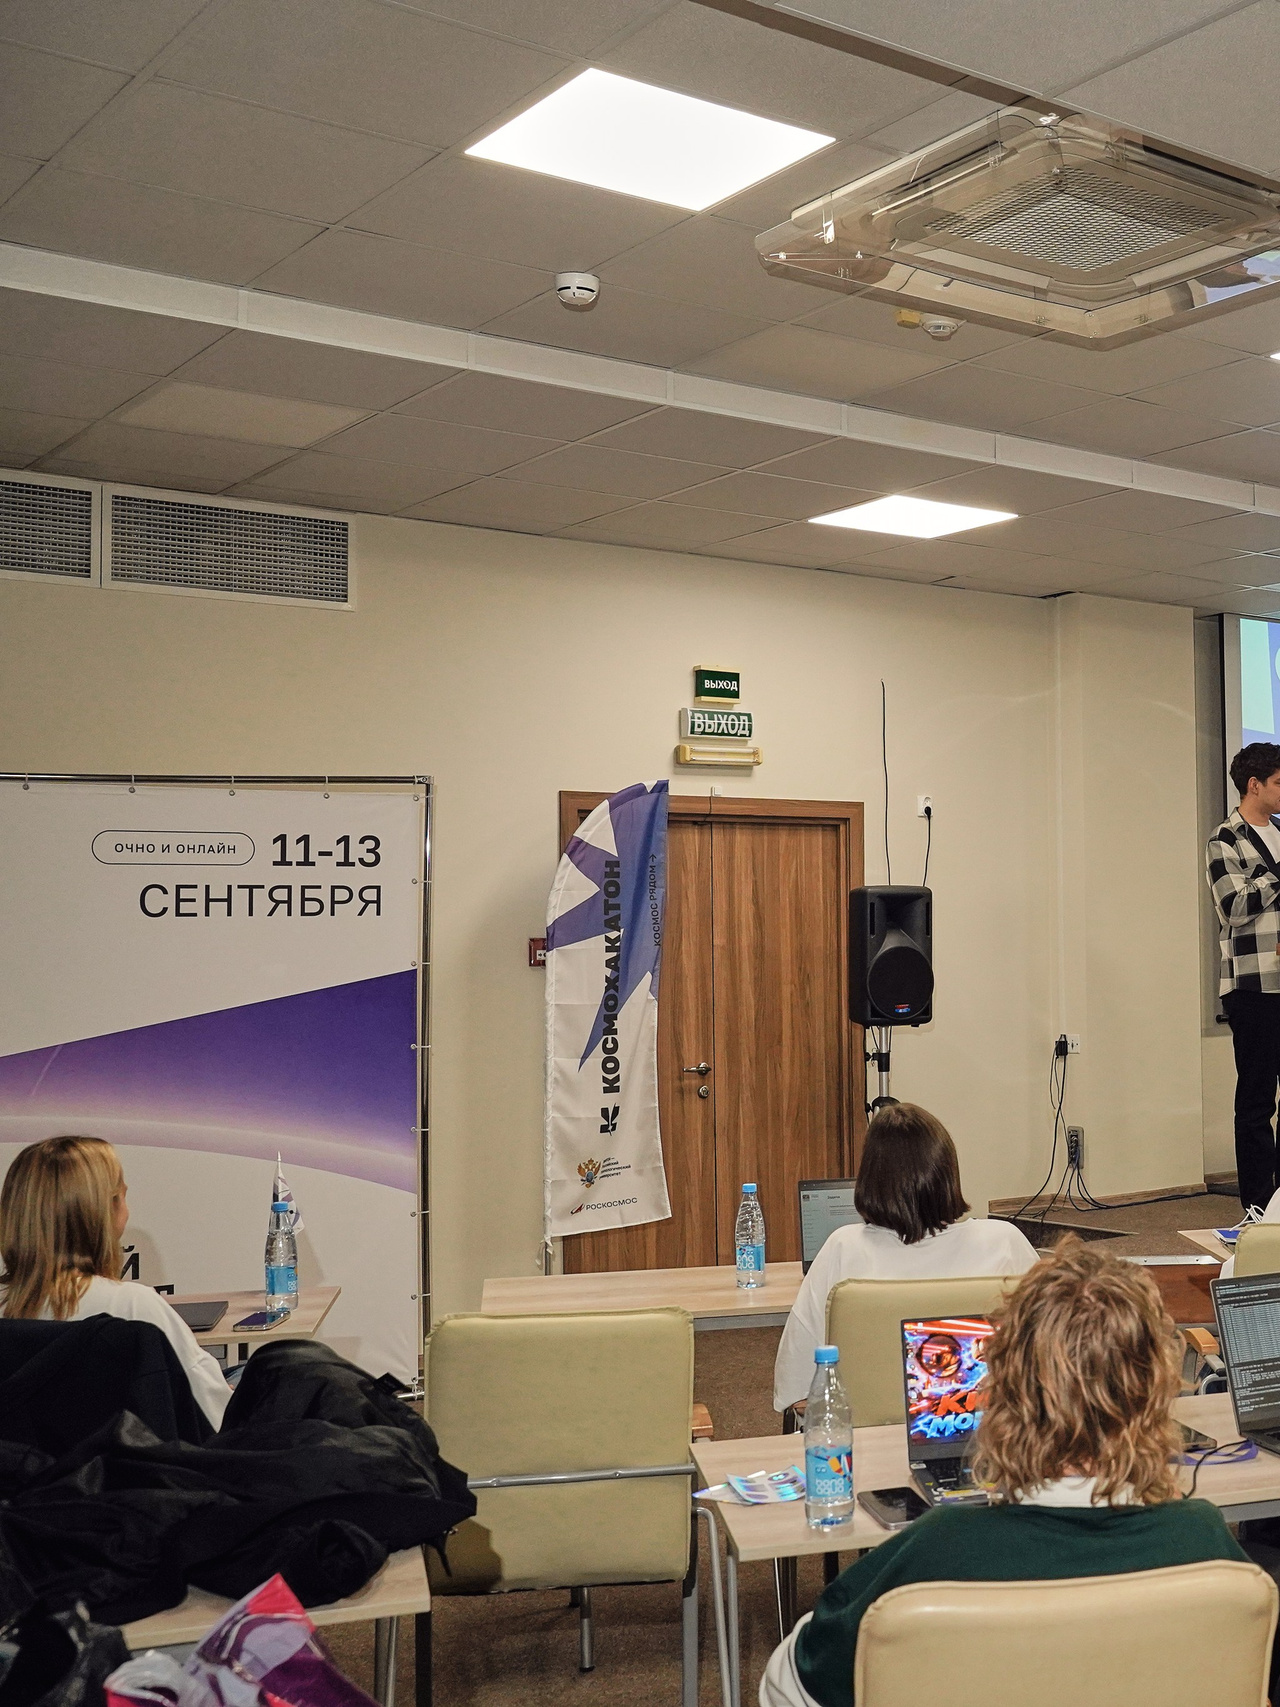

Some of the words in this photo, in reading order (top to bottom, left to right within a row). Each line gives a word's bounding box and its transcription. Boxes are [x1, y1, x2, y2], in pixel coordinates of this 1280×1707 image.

[704, 679, 738, 691] ВЫХОД
[694, 712, 749, 737] ВЫХОД
[114, 842, 156, 854] ОЧНО
[161, 843, 171, 854] И
[175, 842, 237, 855] ОНЛАЙН
[271, 833, 382, 867] 11-13
[648, 865, 658, 901] РЯДОМ
[139, 883, 382, 918] СЕНТЯБРЯ
[650, 903, 661, 947] КОСМОС
[601, 860, 622, 1094] КОСМОХАКАТОН
[586, 1197, 638, 1211] РОСКОСМОС
